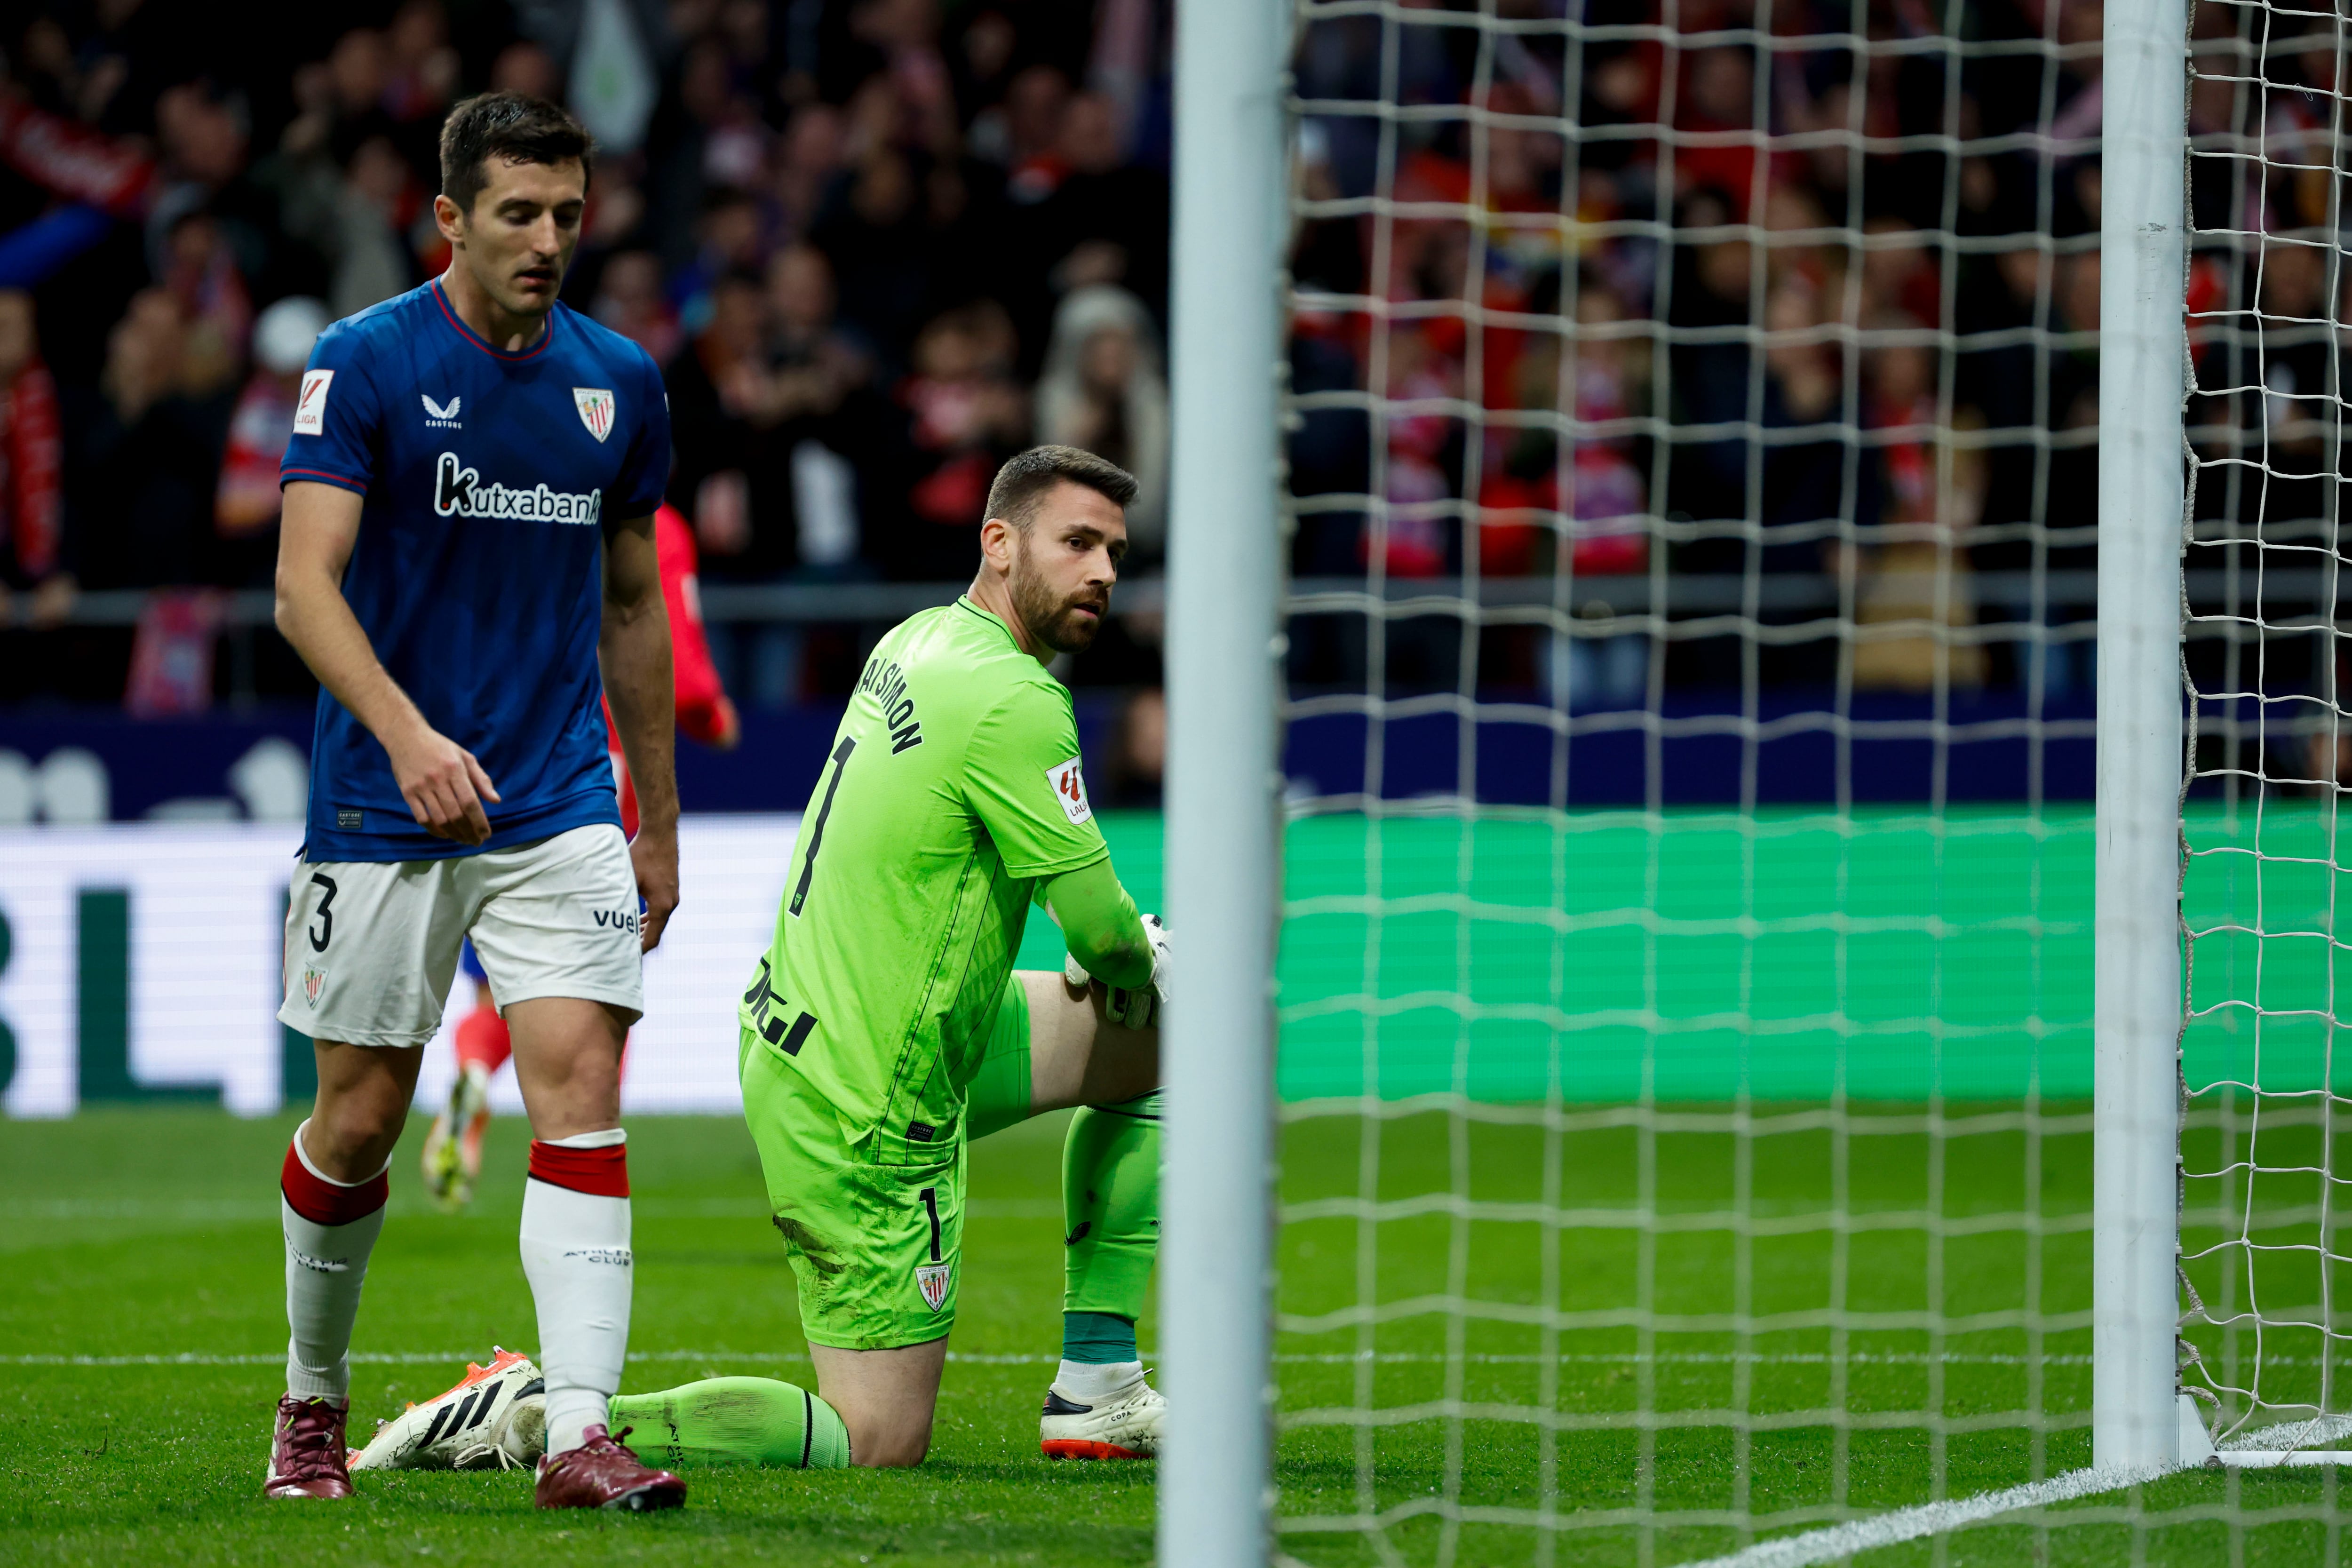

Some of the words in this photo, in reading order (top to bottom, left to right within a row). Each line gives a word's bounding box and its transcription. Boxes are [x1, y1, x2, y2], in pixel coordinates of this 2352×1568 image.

[437, 454, 600, 524] Kutxabank
[788, 735, 857, 918] 1
[310, 873, 337, 952] 3
[918, 1186, 942, 1262] 1
[563, 1250, 634, 1258] ATHLET
[588, 1256, 629, 1266] CLUB
[929, 1297, 943, 1310] BILBAO
[1111, 1410, 1132, 1422] COPA
